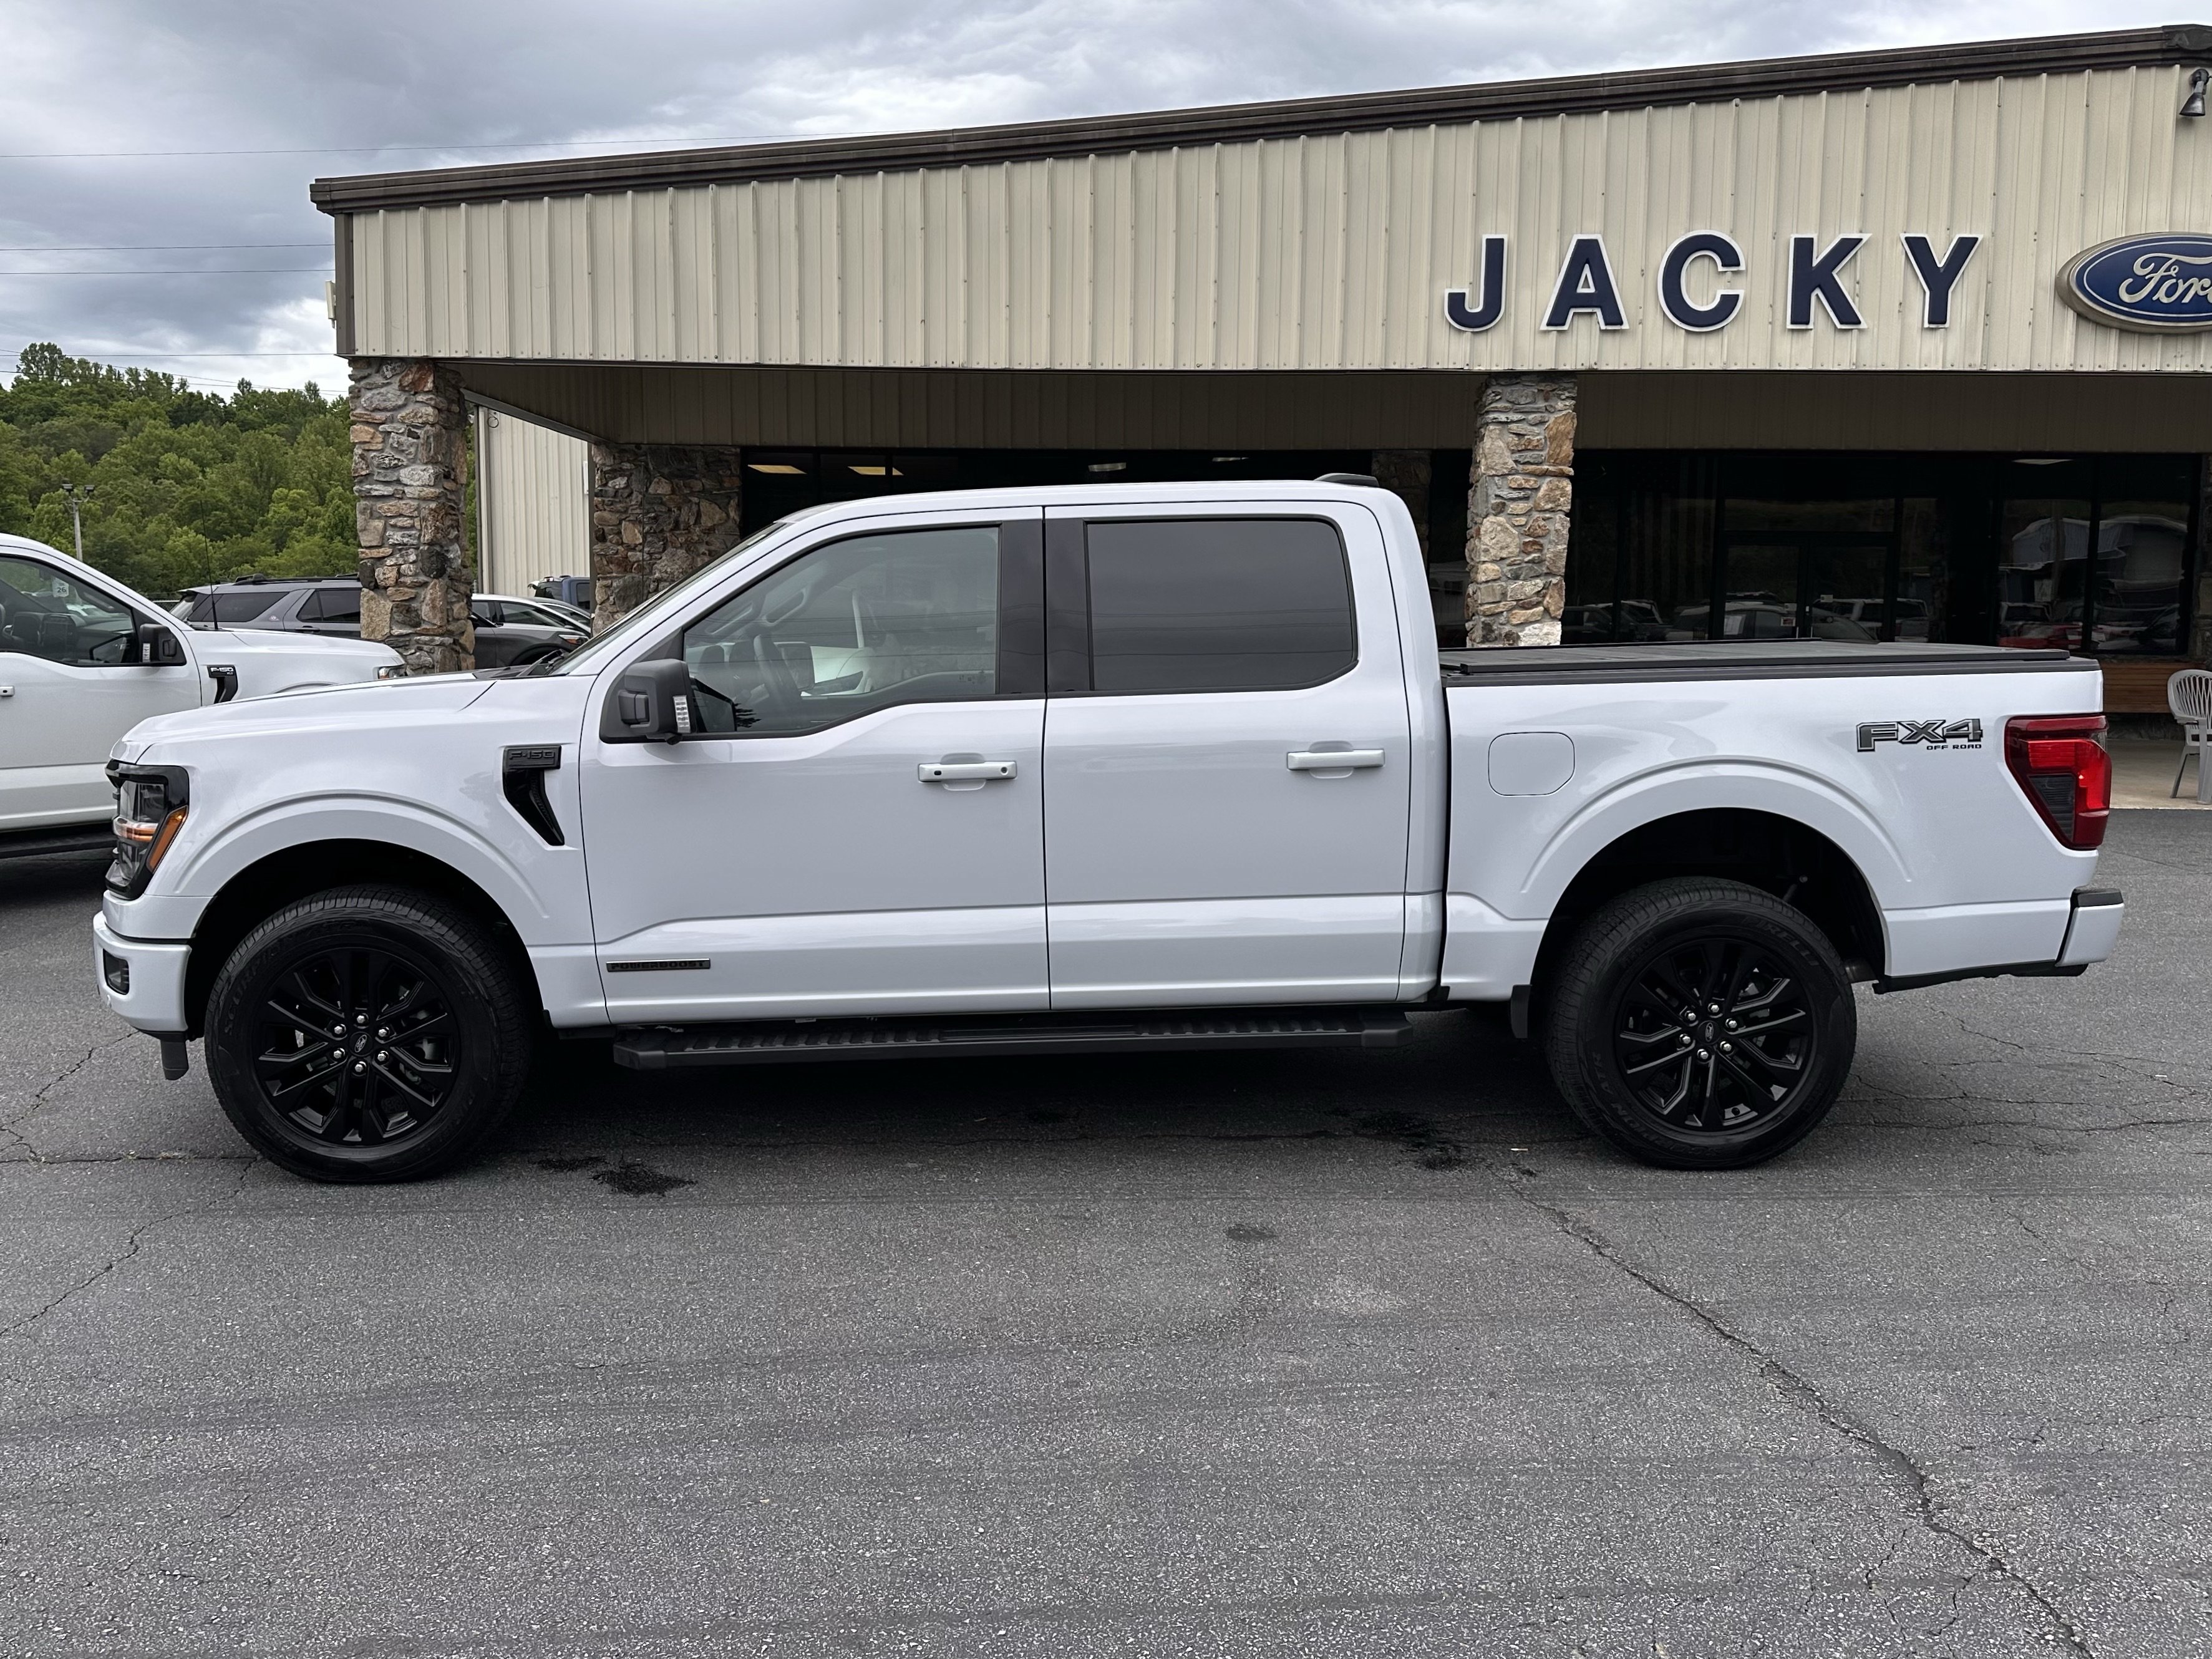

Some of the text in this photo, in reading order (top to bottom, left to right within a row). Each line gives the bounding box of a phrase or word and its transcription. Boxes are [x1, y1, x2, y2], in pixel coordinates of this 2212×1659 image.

[1444, 230, 1983, 332] JACKY
[2118, 253, 2212, 304] For
[509, 750, 555, 760] F-150
[1856, 718, 1983, 752] FX4
[1741, 915, 1820, 966] PIRELLI
[610, 960, 706, 970] POWERBOOST
